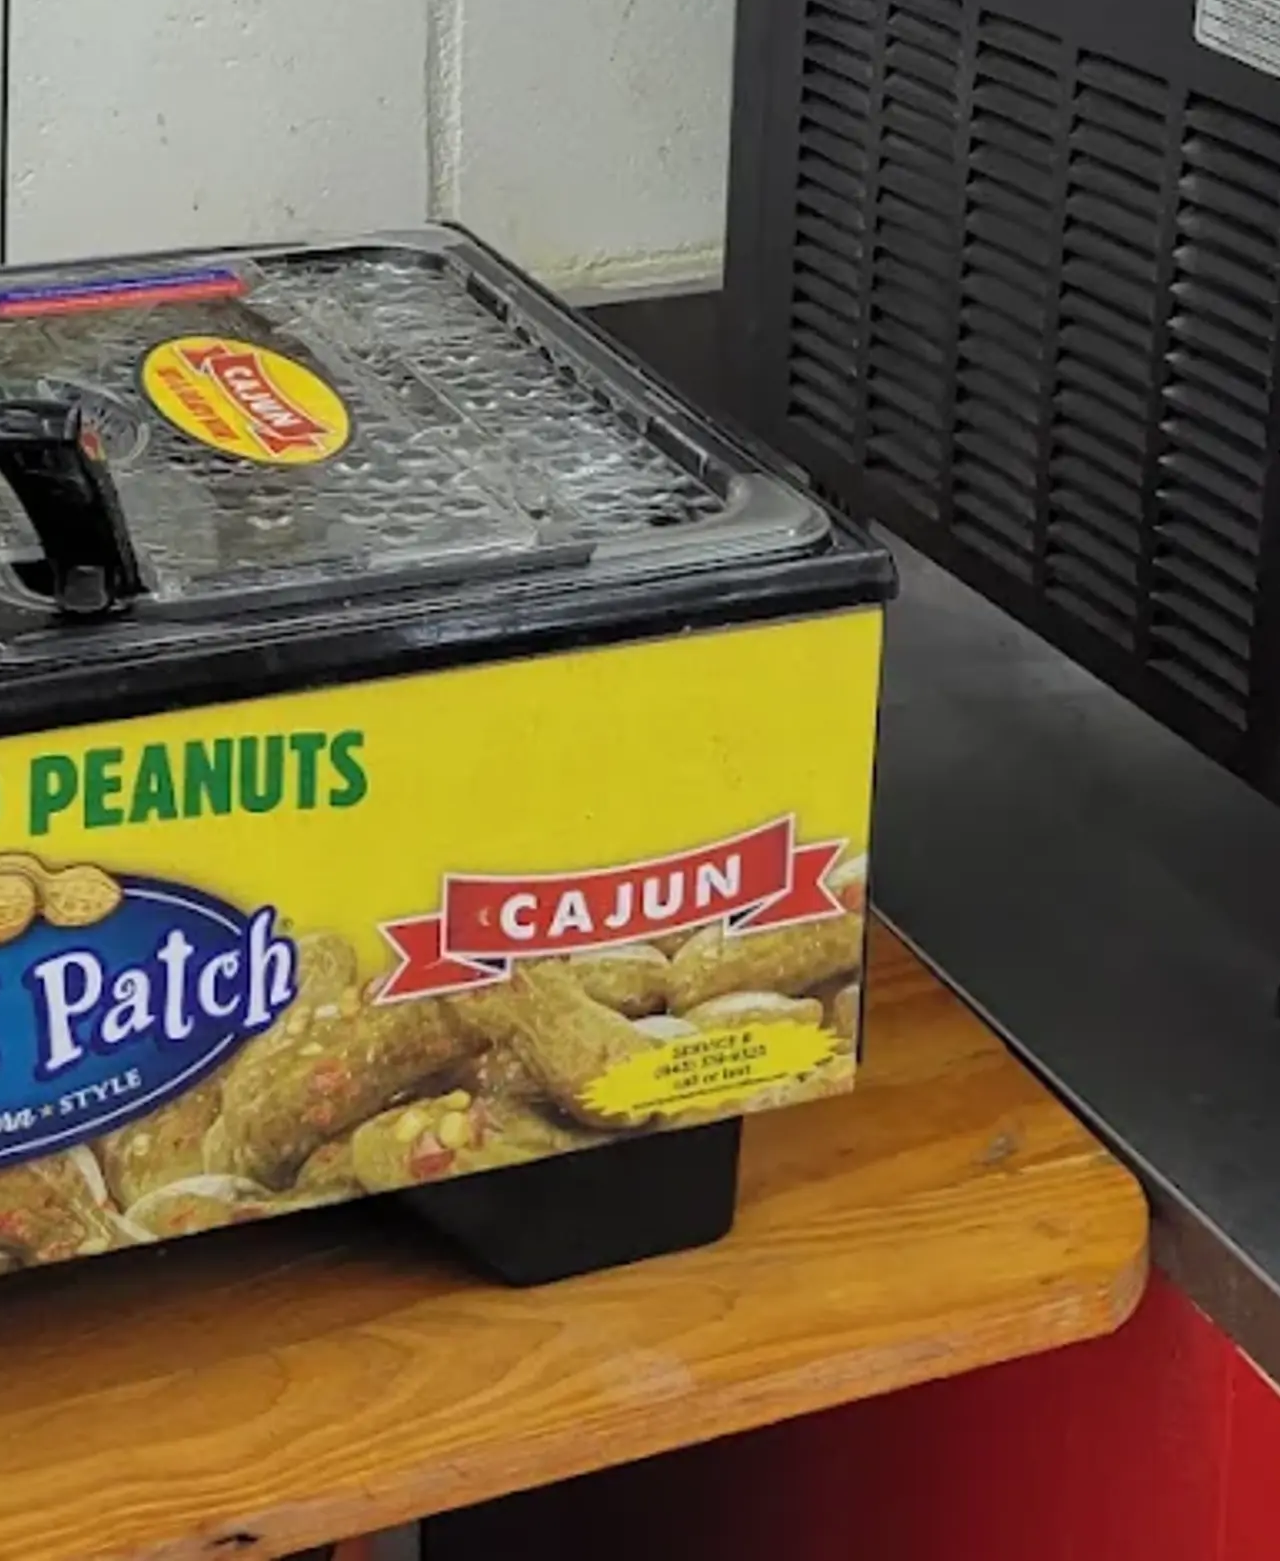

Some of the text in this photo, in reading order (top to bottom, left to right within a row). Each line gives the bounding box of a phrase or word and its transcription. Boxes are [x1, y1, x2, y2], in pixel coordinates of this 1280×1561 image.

[223, 365, 303, 427] CAJUN
[29, 731, 368, 836] PEANUTS
[499, 854, 741, 940] CAJUN
[33, 908, 297, 1073] Patch
[59, 1068, 141, 1114] STYLE
